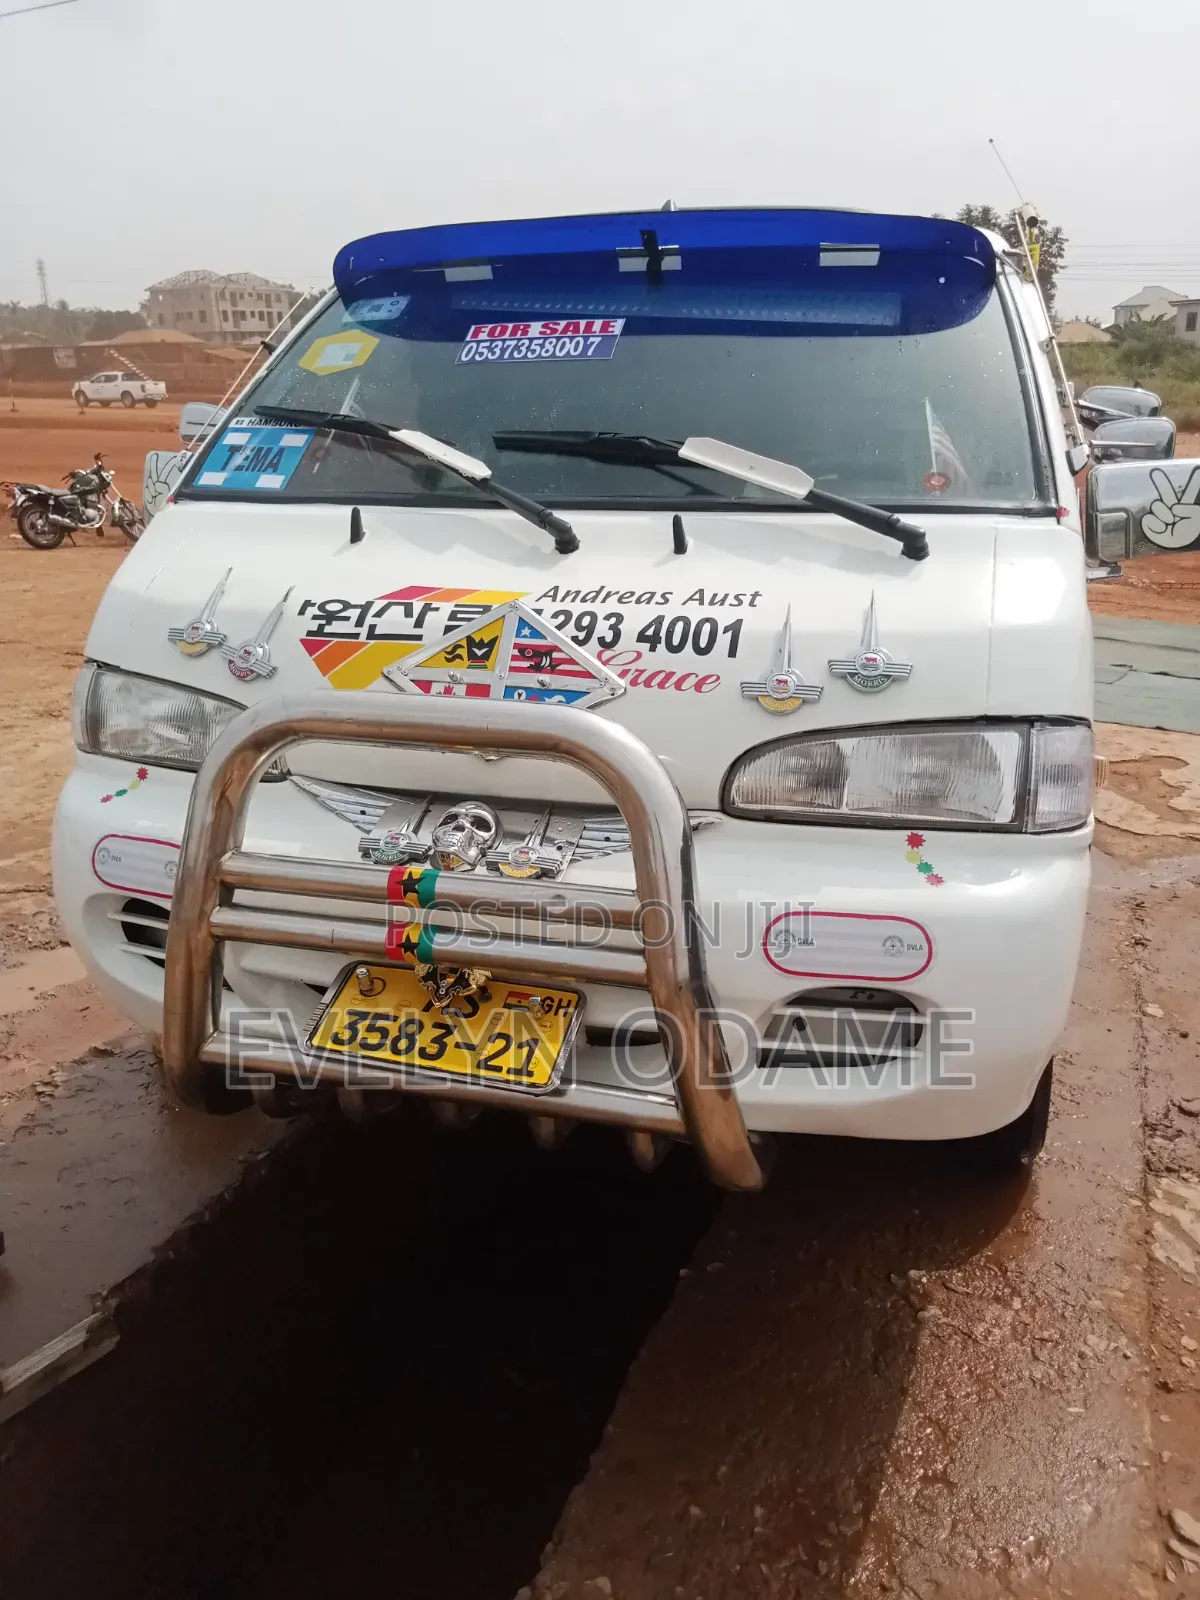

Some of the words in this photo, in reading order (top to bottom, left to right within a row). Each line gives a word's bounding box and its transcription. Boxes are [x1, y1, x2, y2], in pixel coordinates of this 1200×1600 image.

[470, 323, 532, 339] FOR
[539, 320, 617, 336] SALE
[461, 337, 602, 361] 0537358007
[247, 419, 302, 428] HAMBUR
[221, 446, 286, 473] TEMA
[535, 585, 673, 605] Andreas
[681, 588, 763, 608] Aust
[531, 608, 625, 650] 293
[636, 614, 744, 659] 4001
[229, 661, 252, 679] MORRIS
[852, 674, 888, 689] MORRIS
[906, 944, 923, 952] DVLA
[541, 996, 571, 1017] GH
[330, 1008, 540, 1077] 3583-21
